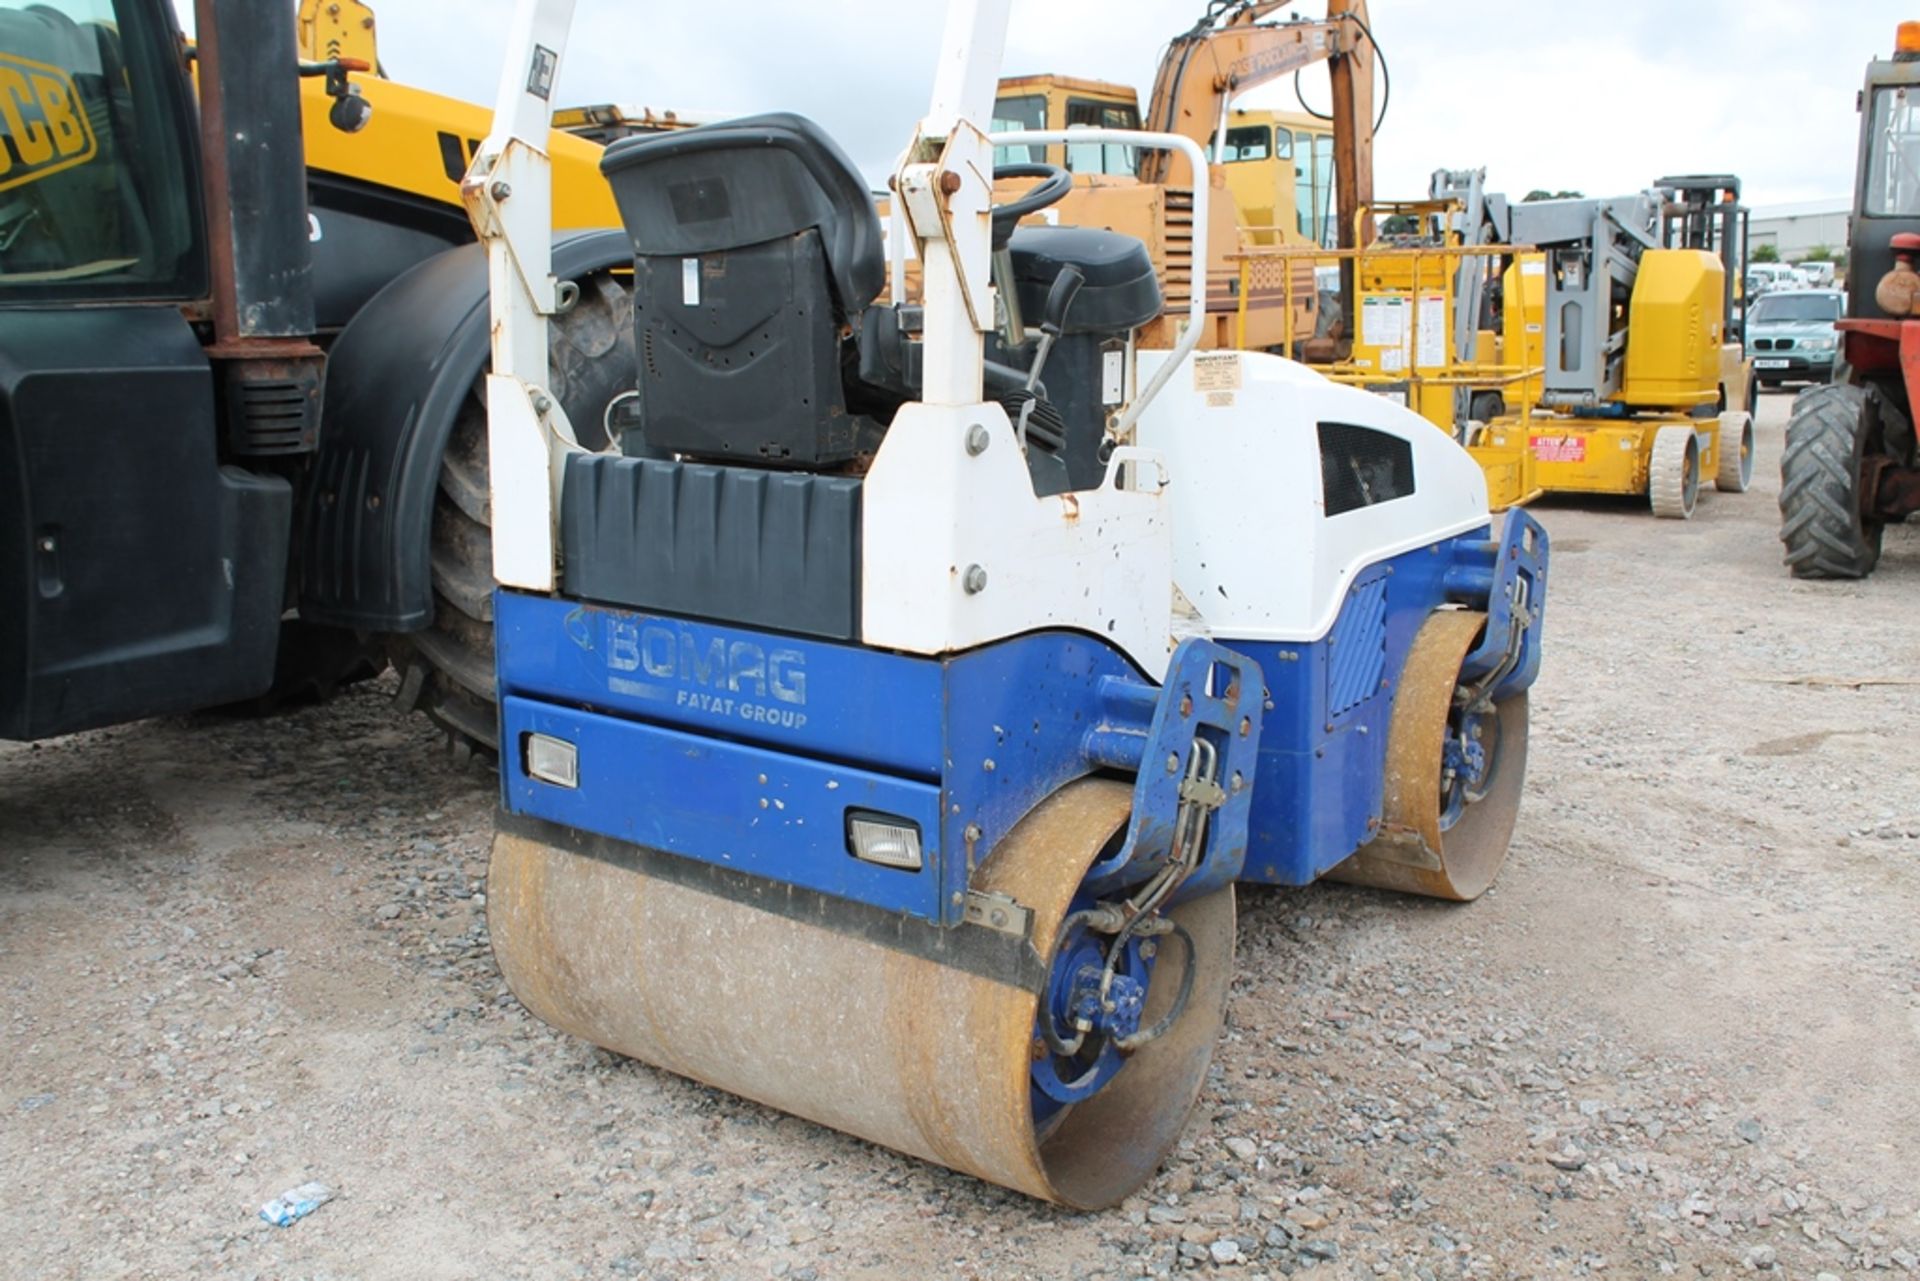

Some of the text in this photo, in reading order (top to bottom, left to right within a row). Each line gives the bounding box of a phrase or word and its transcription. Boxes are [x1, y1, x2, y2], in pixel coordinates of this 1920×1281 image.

[0, 66, 84, 174] CB
[607, 617, 806, 705] BOMAG
[676, 690, 807, 730] FAYAT GROUP
